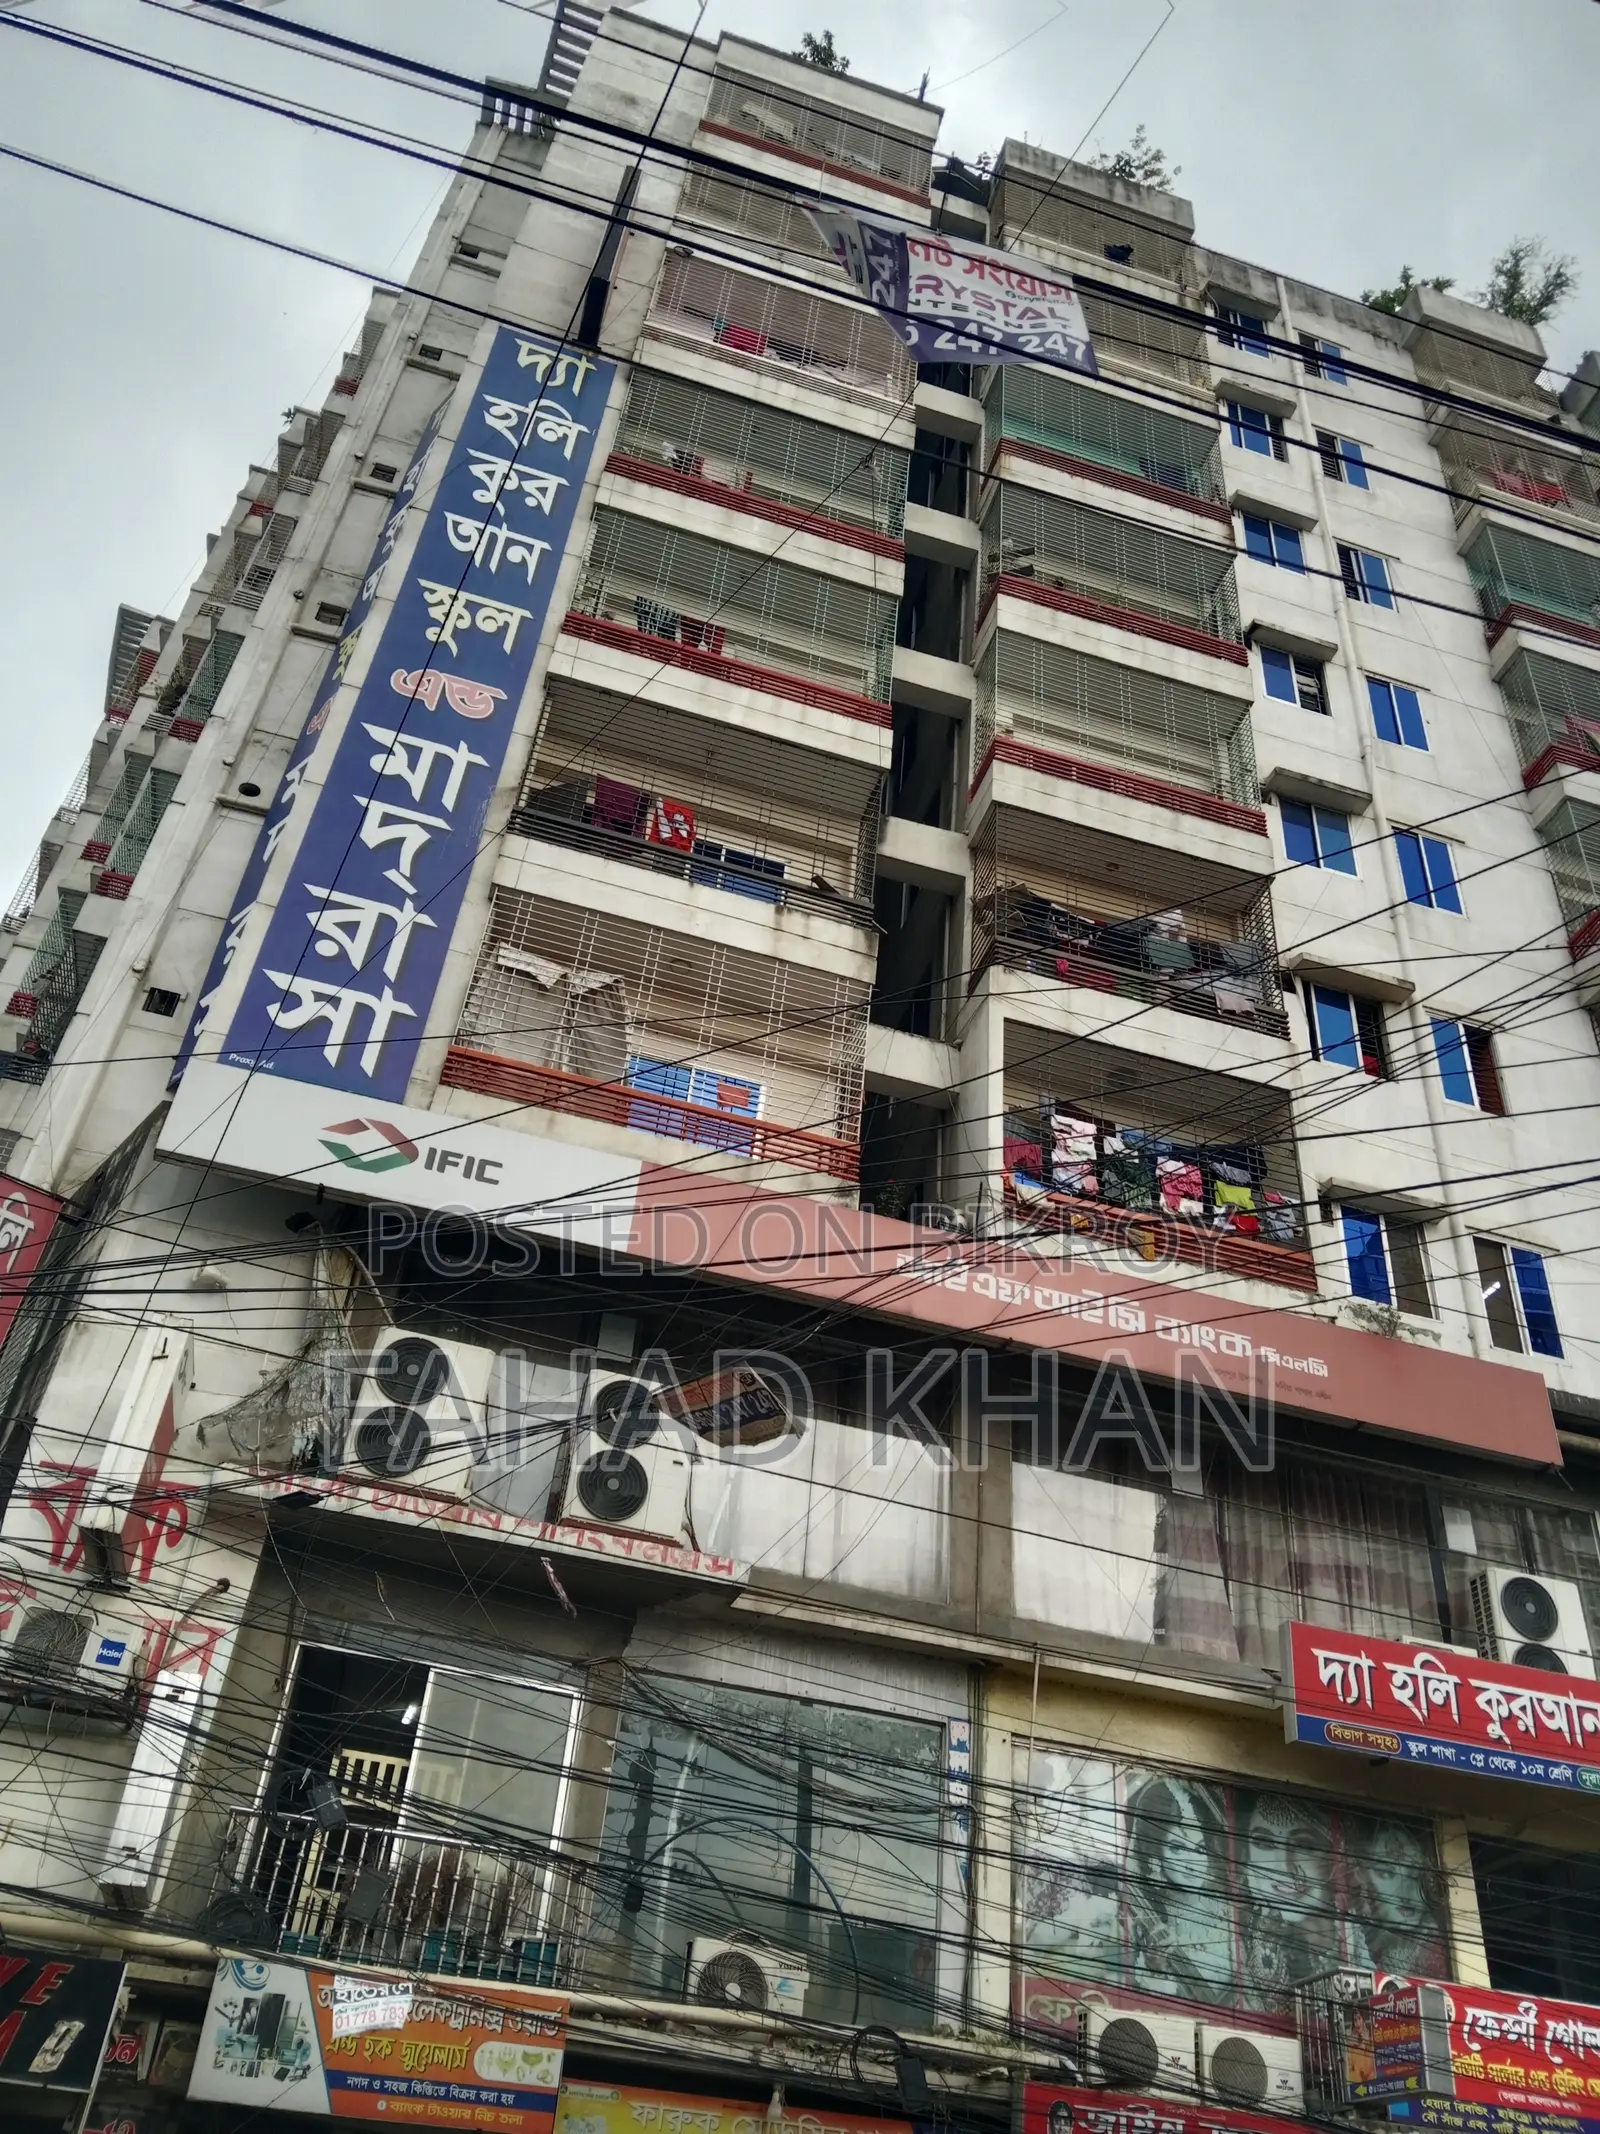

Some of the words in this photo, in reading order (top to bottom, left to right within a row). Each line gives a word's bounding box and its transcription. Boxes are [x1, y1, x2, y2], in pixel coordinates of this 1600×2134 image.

[908, 298, 1073, 331] NTERNET
[909, 275, 1072, 322] RYSTAL
[514, 338, 597, 397] দ্যা
[1018, 332, 1087, 361] 247
[482, 393, 591, 462] হলি
[469, 448, 571, 517] কুর
[443, 511, 553, 586] আন
[417, 578, 534, 658] স্কুল
[360, 722, 490, 813] মা
[303, 883, 438, 984] রা
[262, 969, 418, 1078] সা
[228, 1053, 256, 1067] Proxy
[424, 1147, 503, 1185] IFIC
[1153, 1314, 1253, 1359] ব্যাংক
[98, 1647, 124, 1659] Haier
[1310, 1648, 1377, 1709] দ্যা
[1383, 1652, 1462, 1726] হলি
[1468, 1678, 1600, 1750] কুরআন
[1330, 1722, 1364, 1743] বিভাগ
[1366, 1732, 1399, 1751] সমূহঃ
[1405, 1739, 1428, 1759] স্কুল
[1430, 1744, 1456, 1762] শাখা
[1470, 1752, 1485, 1768] প্লে
[1488, 1755, 1517, 1772] থেকে
[1520, 1761, 1544, 1777] ১০ম
[335, 2009, 377, 2030] 01778
[382, 2006, 405, 2021] 783
[347, 2076, 369, 2089] নগদ
[372, 2081, 380, 2090] ও
[384, 2079, 408, 2094] সহজ
[479, 2091, 498, 2104] করা
[500, 2093, 515, 2105] হয়
[390, 2101, 424, 2115] ব্যাংক
[427, 2106, 471, 2120] টাওয়ার
[499, 2114, 524, 2126] তলা
